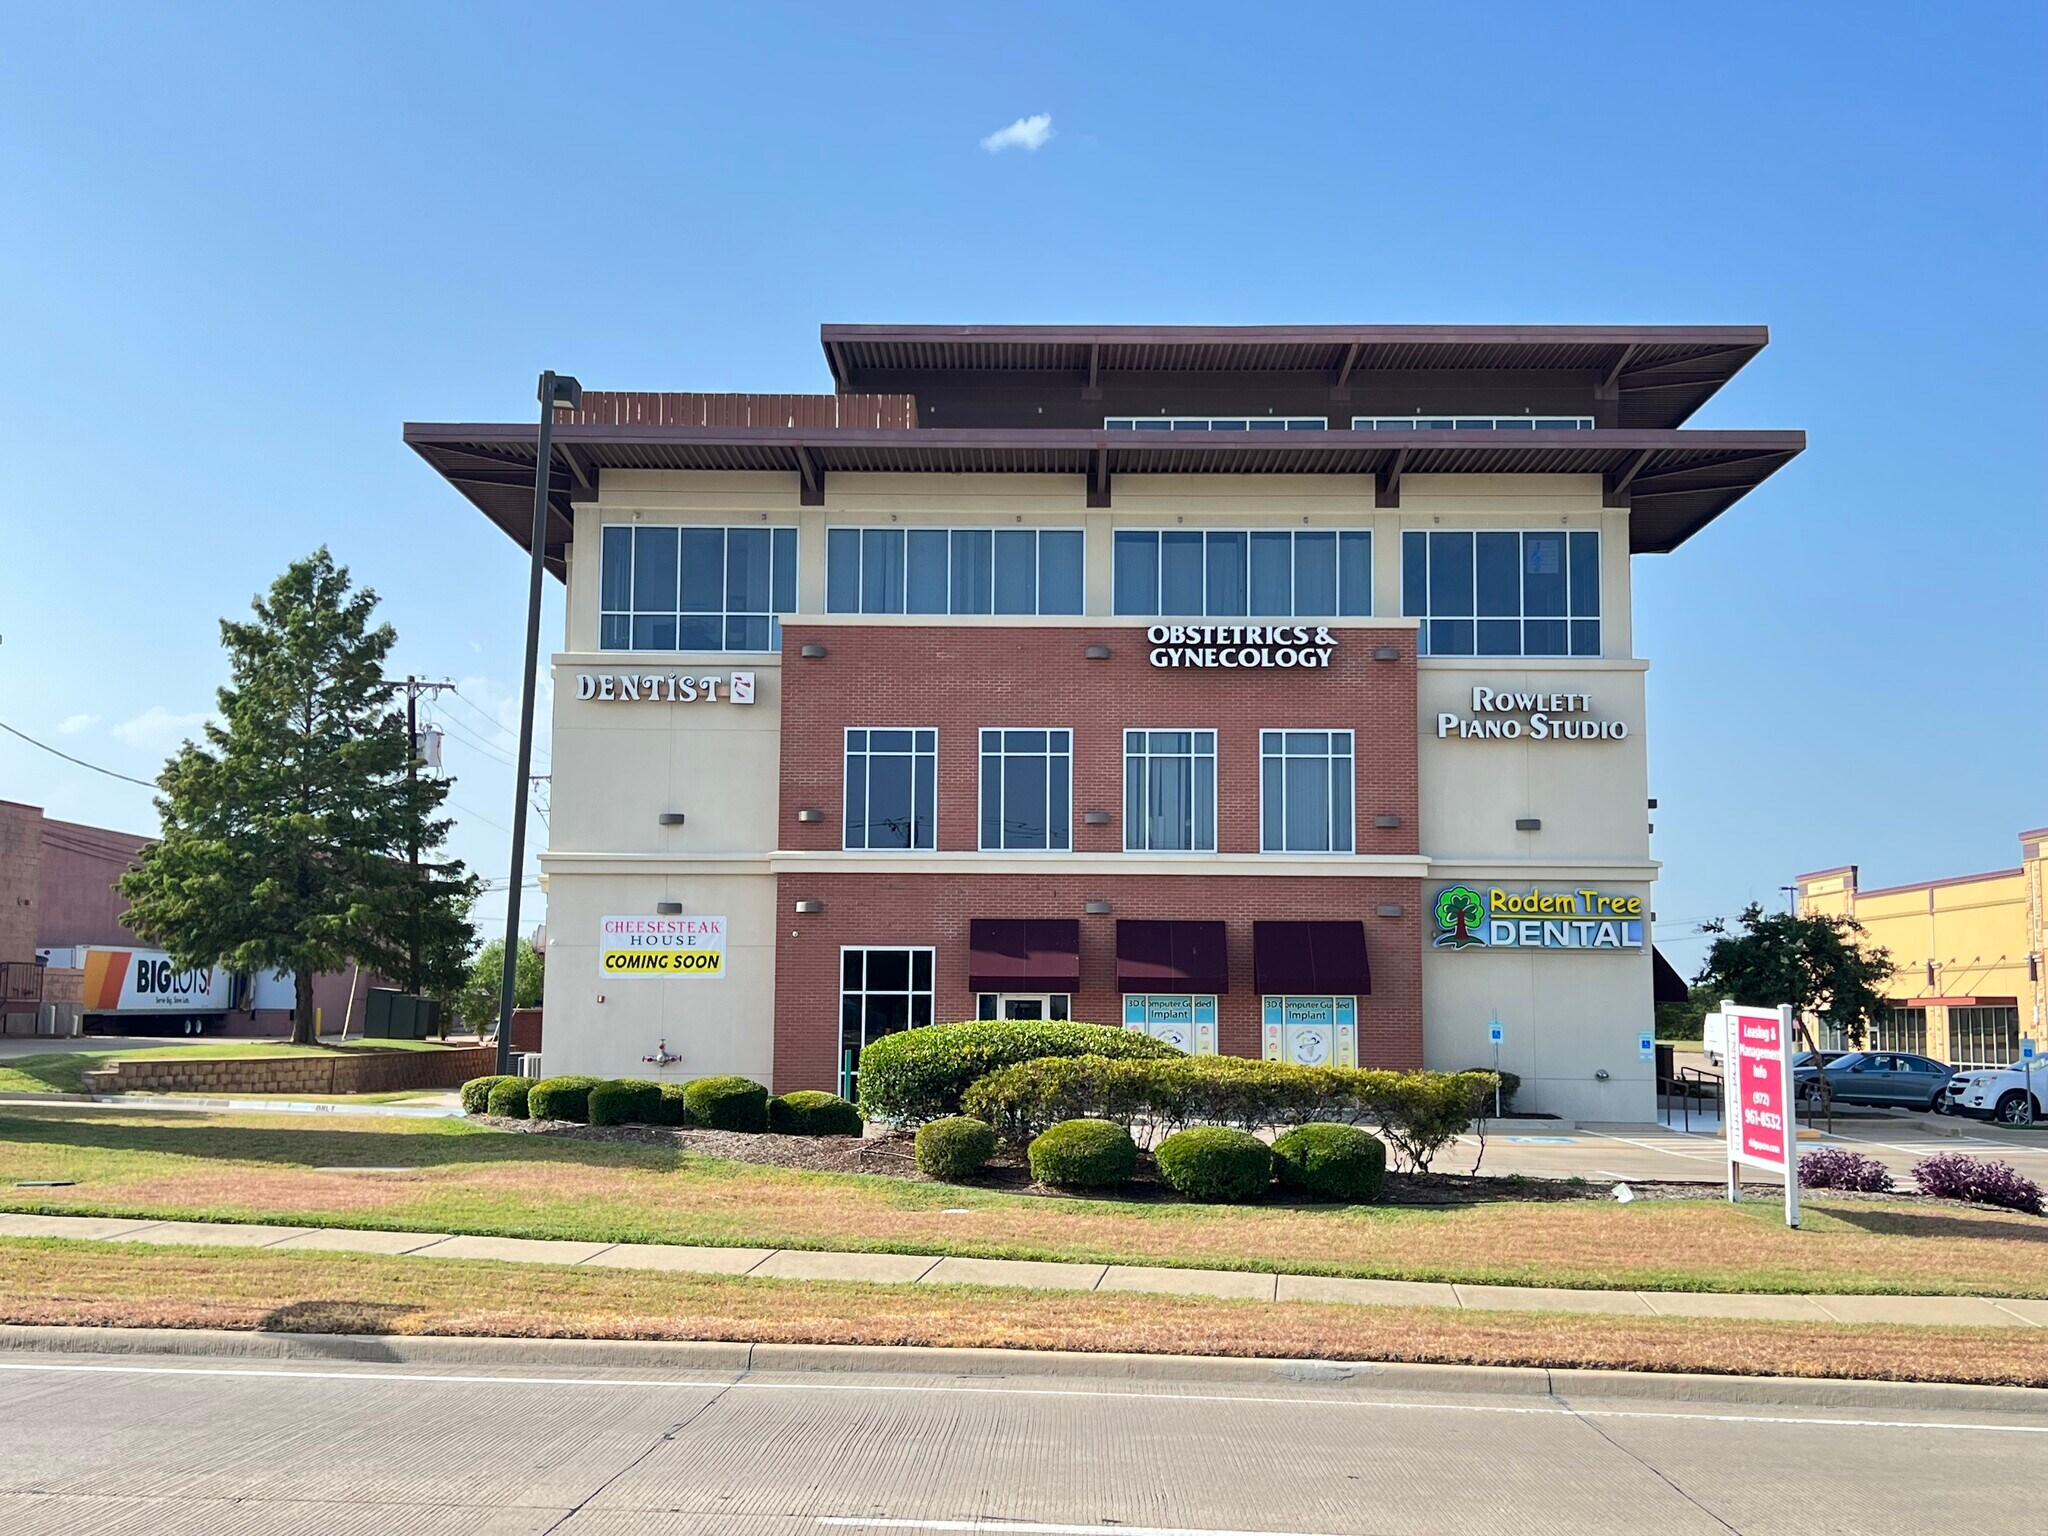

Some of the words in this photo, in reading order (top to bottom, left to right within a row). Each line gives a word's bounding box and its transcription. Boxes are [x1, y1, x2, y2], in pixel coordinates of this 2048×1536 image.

[1147, 624, 1309, 645] OBSTETRICS
[1314, 625, 1339, 645] &
[1149, 647, 1333, 668] GYNECOLOGY
[1471, 686, 1592, 712] ROWLETT
[1437, 713, 1521, 739] PIANO
[1529, 713, 1629, 740] STUDIO
[1490, 889, 1576, 913] Rodem
[1579, 890, 1641, 914] Tree
[605, 921, 720, 933] CHEESESTEAK
[1490, 920, 1642, 947] DENTAL
[630, 935, 697, 946] HOUSE
[605, 955, 669, 969] COMING
[673, 955, 720, 969] SOON
[137, 960, 172, 993] BIG
[1128, 999, 1139, 1007] 3D
[1320, 1001, 1350, 1009] Guded
[1151, 1010, 1188, 1020] Implant
[1289, 1011, 1326, 1021] Implant
[1743, 1024, 1770, 1042] Leasing
[1770, 1026, 1777, 1041] &
[1752, 1064, 1768, 1080] Info
[1752, 1091, 1770, 1107] (972)
[1744, 1108, 1782, 1131] 961-8532
